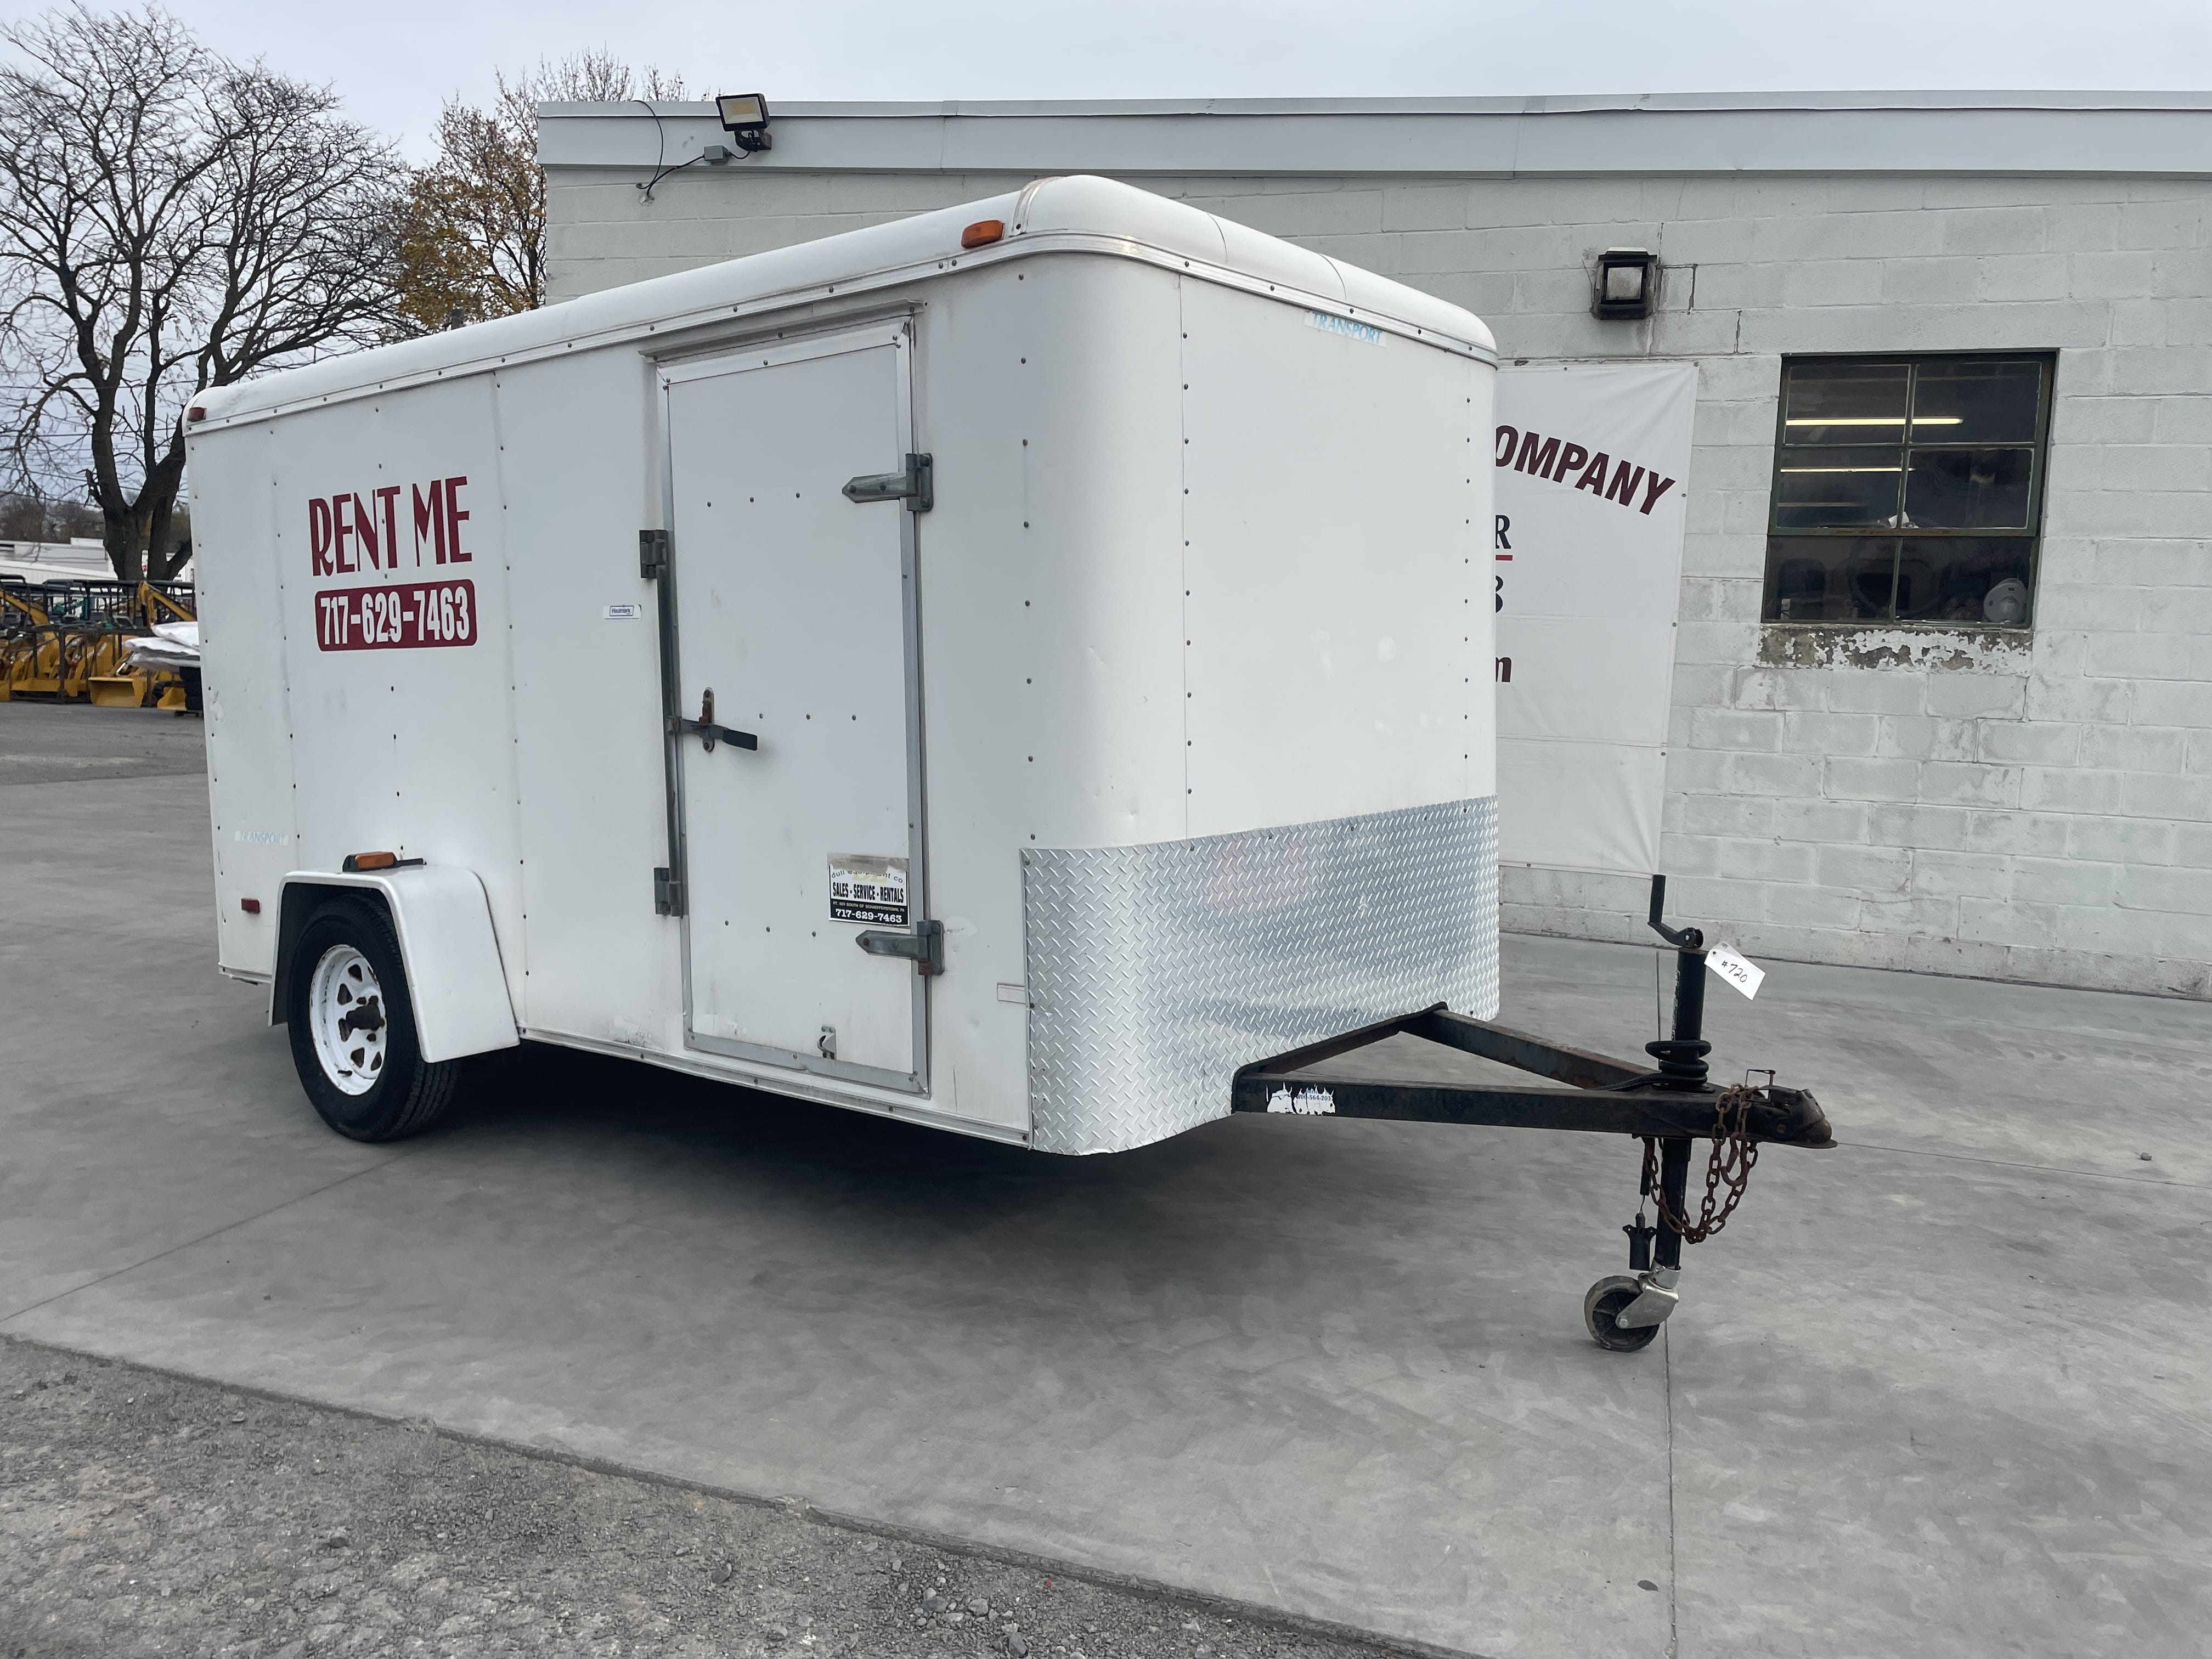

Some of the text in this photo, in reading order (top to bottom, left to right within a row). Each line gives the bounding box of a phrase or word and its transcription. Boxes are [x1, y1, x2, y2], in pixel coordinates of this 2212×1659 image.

[1312, 312, 1383, 344] TRANSPORT
[1495, 424, 1676, 516] OMPANY
[308, 476, 473, 577] RENT ME
[320, 586, 470, 645] 717-629-7463
[833, 882, 904, 904] SALES SERVICE RENTALS
[836, 908, 902, 923] 717-629-7463
[1722, 960, 1747, 983] #720
